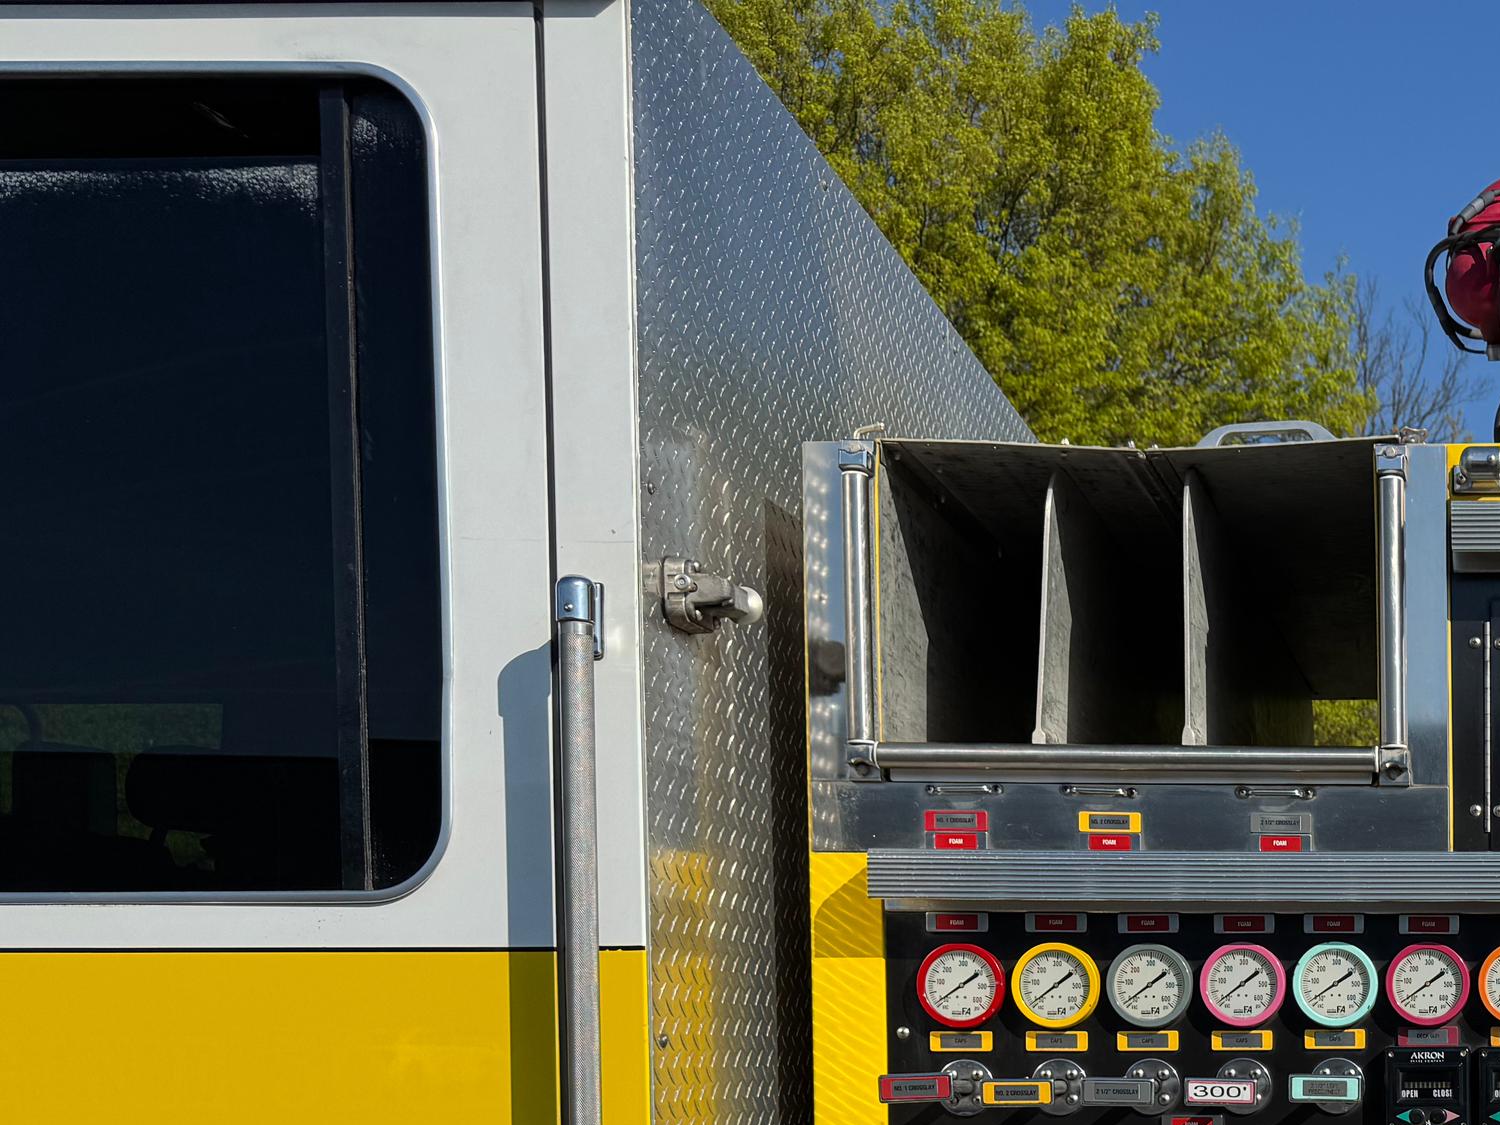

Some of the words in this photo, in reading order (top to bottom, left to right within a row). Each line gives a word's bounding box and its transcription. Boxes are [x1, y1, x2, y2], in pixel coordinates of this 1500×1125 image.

[962, 1007, 971, 1016] FA
[1410, 1051, 1445, 1059] AKRON
[1194, 1085, 1247, 1098] 300'
[1401, 1089, 1418, 1098] OPEN
